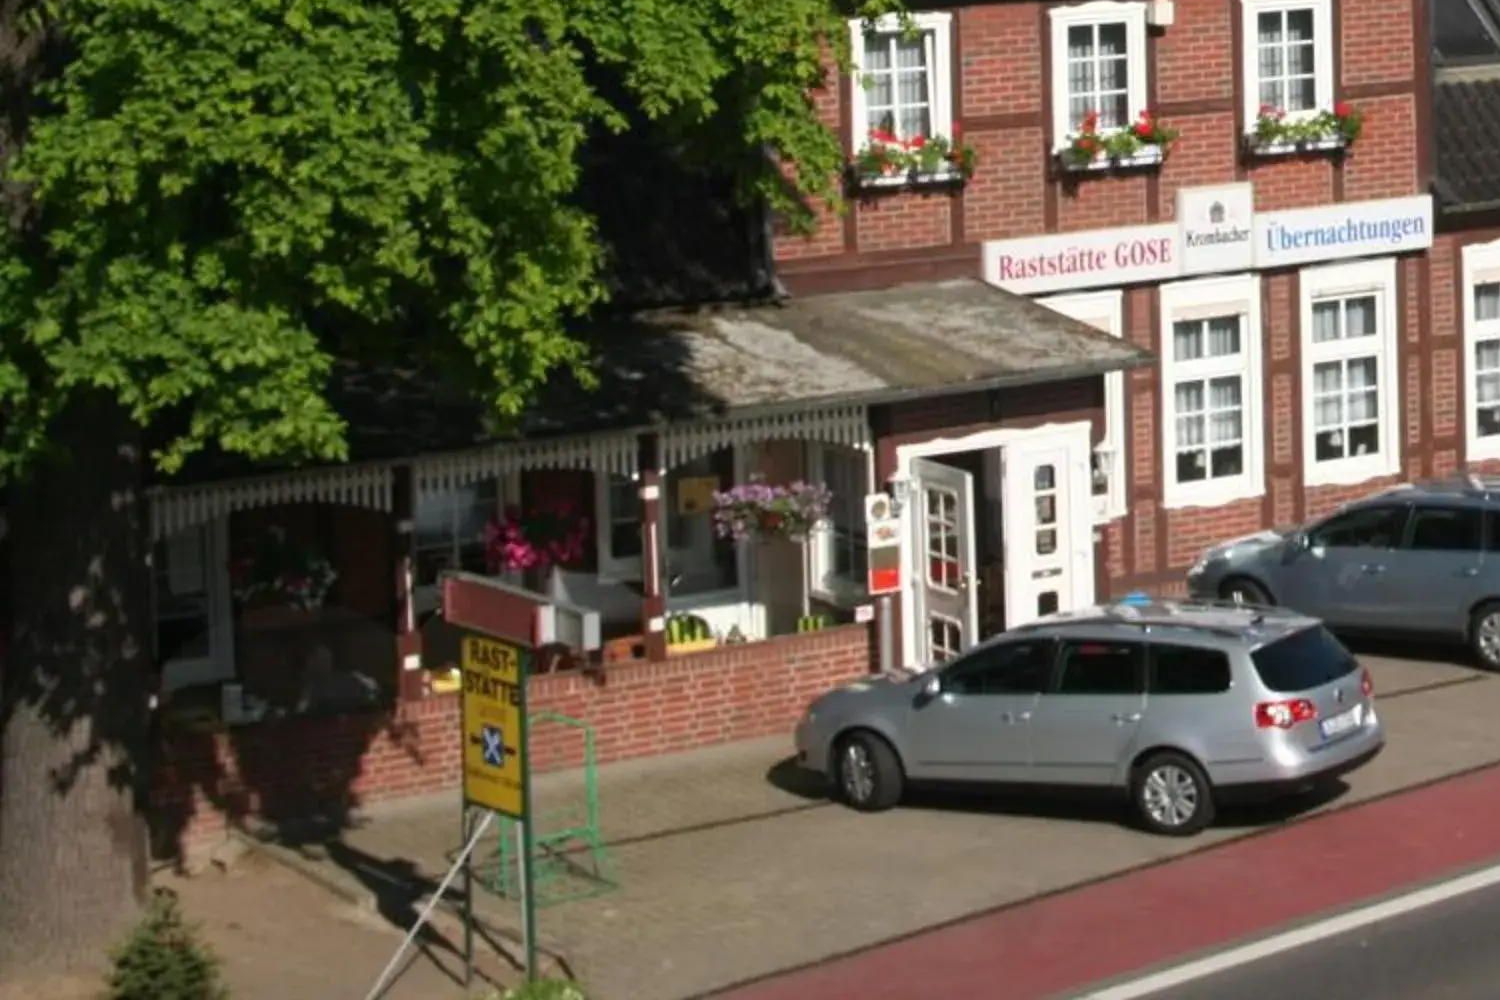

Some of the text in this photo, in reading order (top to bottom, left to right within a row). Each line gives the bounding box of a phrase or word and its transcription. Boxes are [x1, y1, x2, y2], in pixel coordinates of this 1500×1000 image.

[1185, 225, 1251, 249] Krombacher
[1266, 215, 1426, 252] Übernachtungen
[998, 237, 1172, 281] Raststätte GOSE
[469, 639, 516, 673] RAST-
